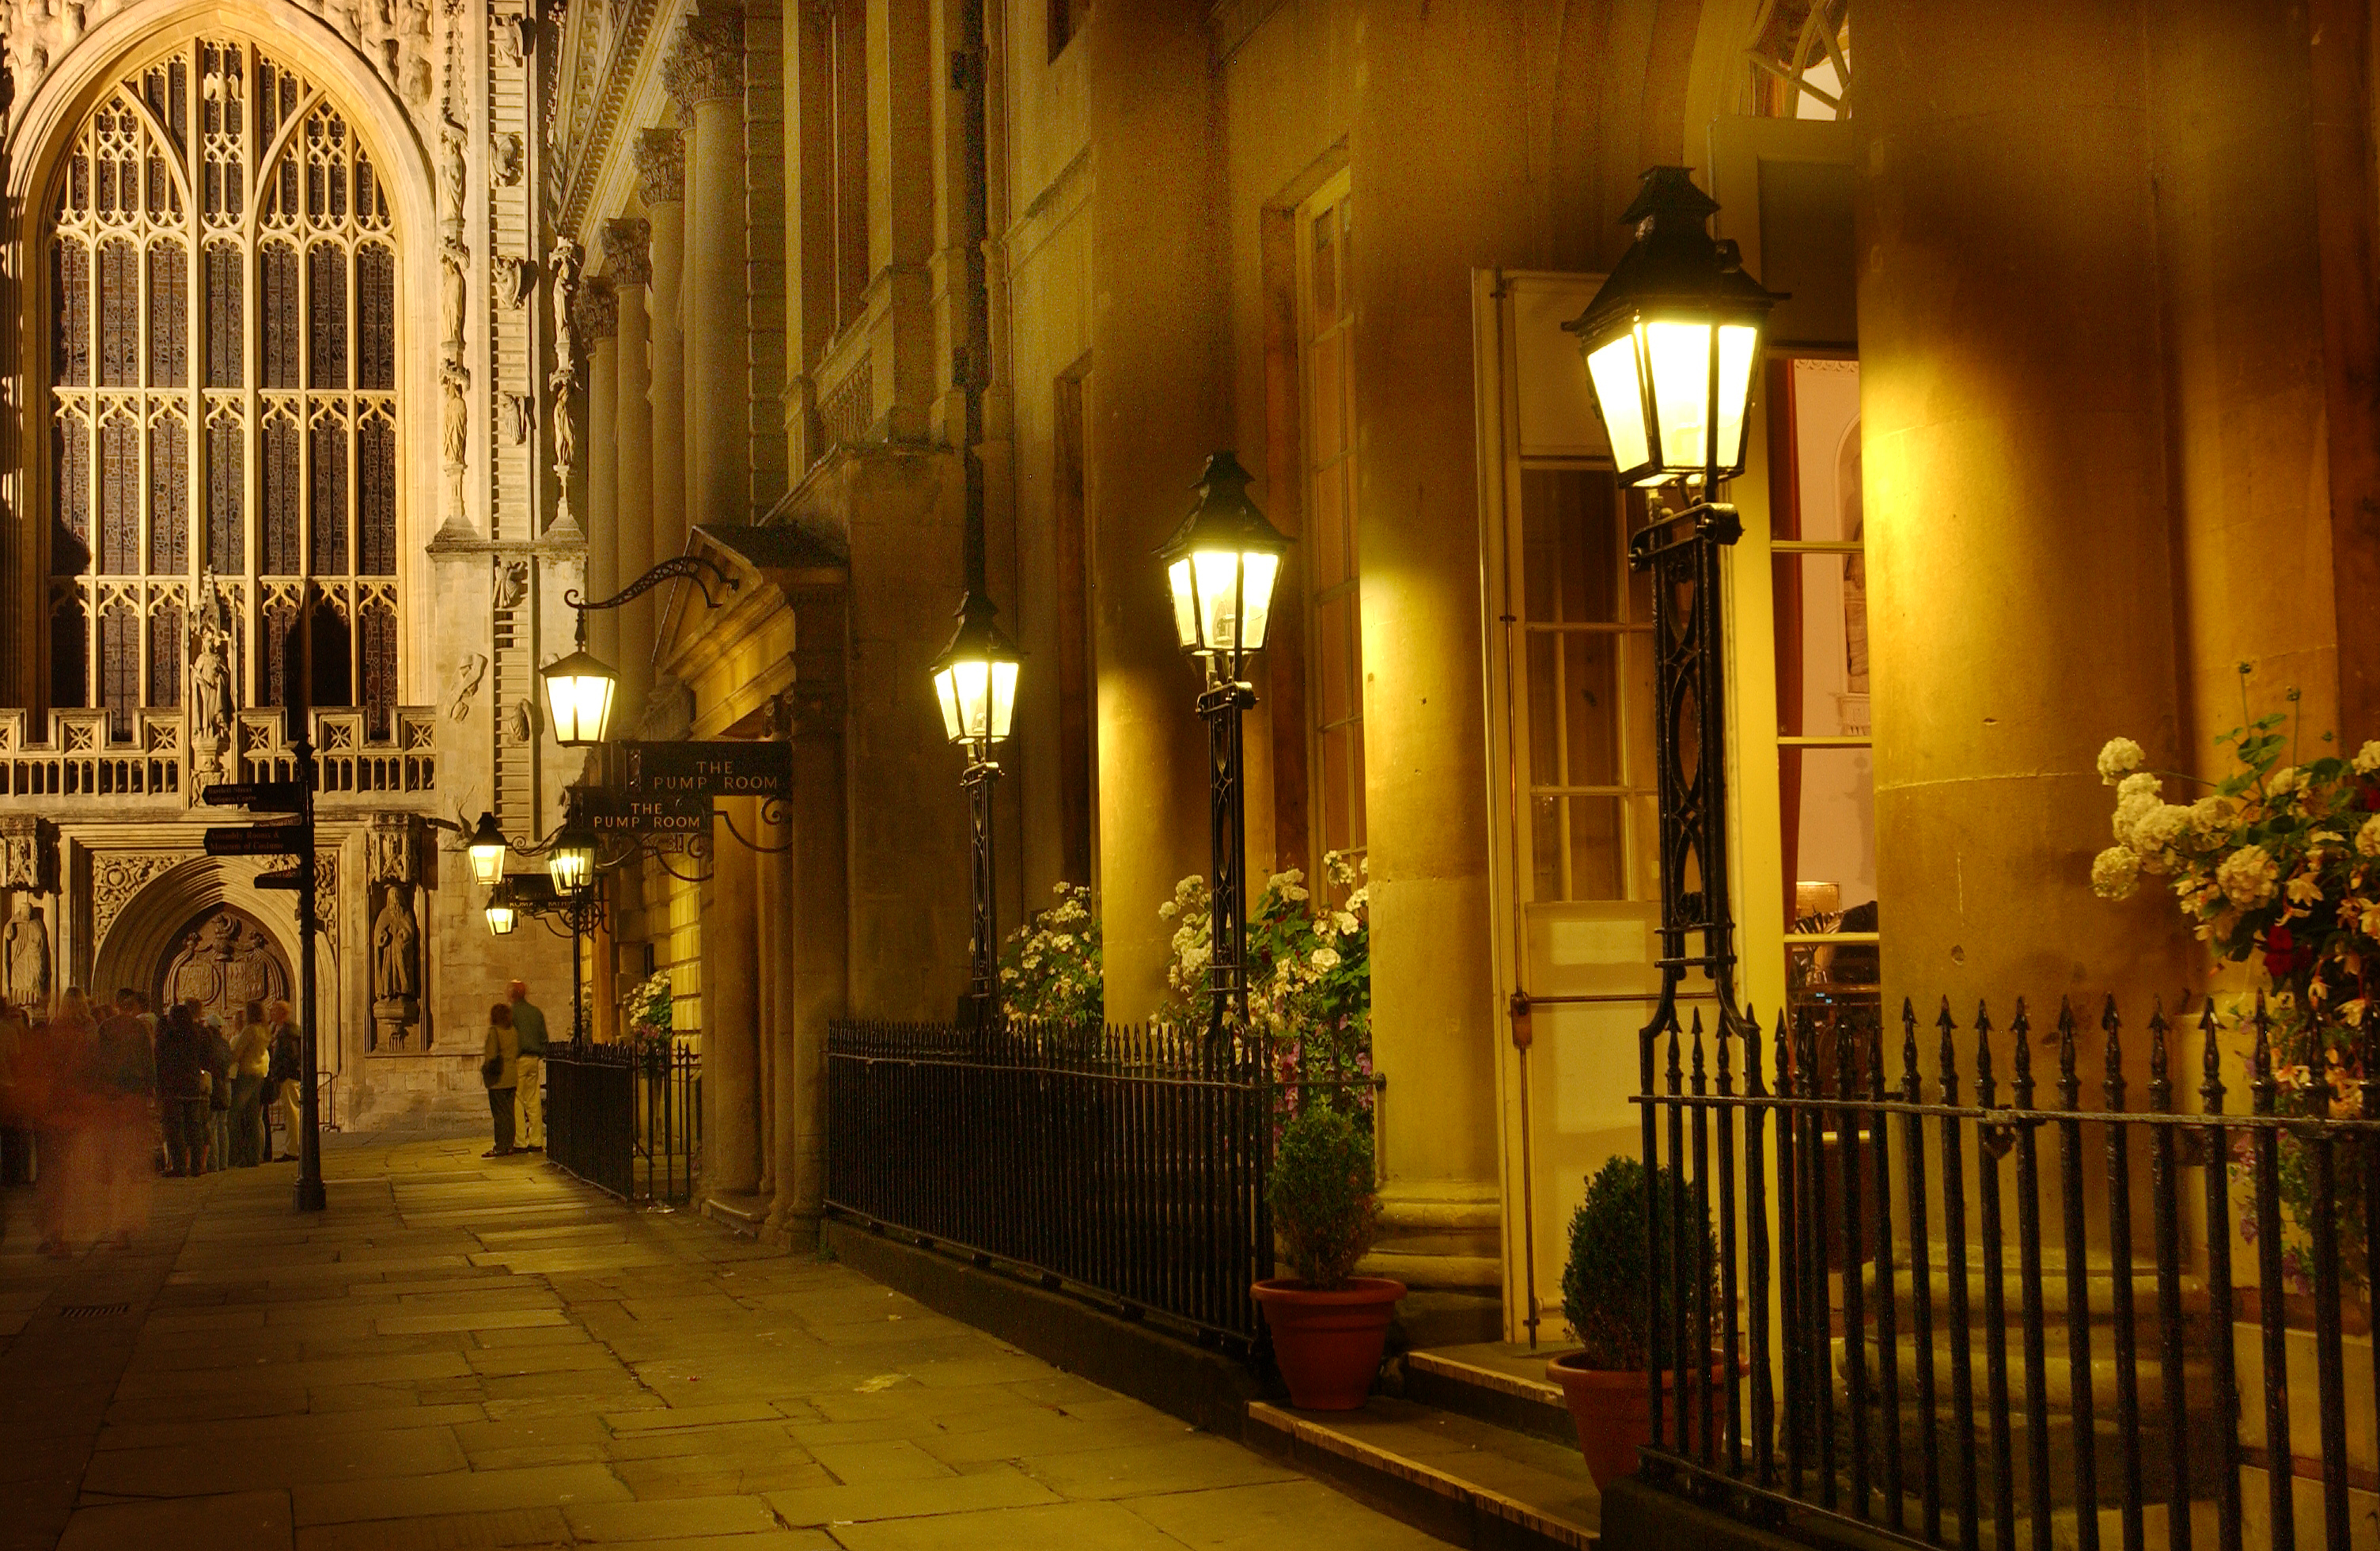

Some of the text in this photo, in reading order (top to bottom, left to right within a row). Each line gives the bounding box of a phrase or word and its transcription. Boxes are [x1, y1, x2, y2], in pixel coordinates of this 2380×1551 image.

[696, 760, 733, 775] THE
[654, 776, 778, 790] PUMP ROOM
[630, 802, 663, 814] THE
[594, 815, 700, 829] PUMP ROOM
[210, 831, 242, 840] Assembly
[210, 842, 241, 851] Museum
[252, 841, 284, 850] Costume
